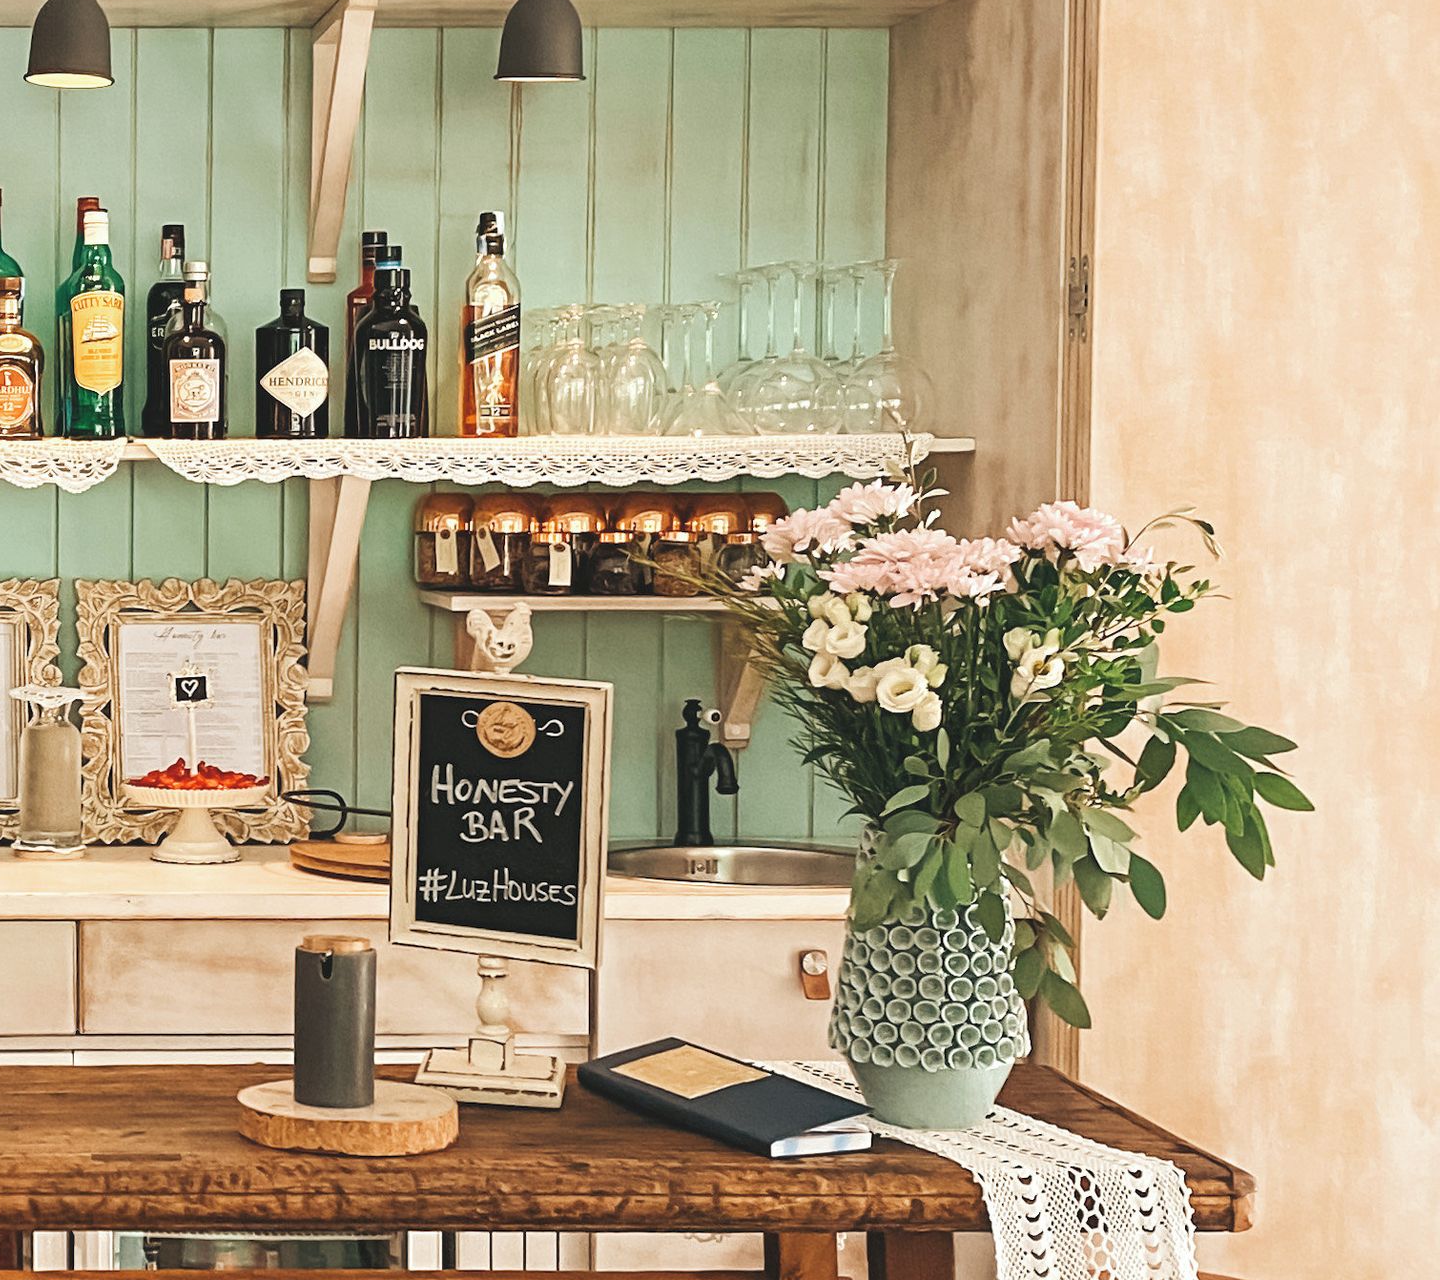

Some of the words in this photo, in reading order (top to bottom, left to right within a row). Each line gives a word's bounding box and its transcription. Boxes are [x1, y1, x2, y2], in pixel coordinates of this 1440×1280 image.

[369, 338, 424, 351] BULLDOG
[269, 377, 329, 387] HENDRICK
[2, 401, 15, 412] 12
[460, 806, 543, 844] BAR
